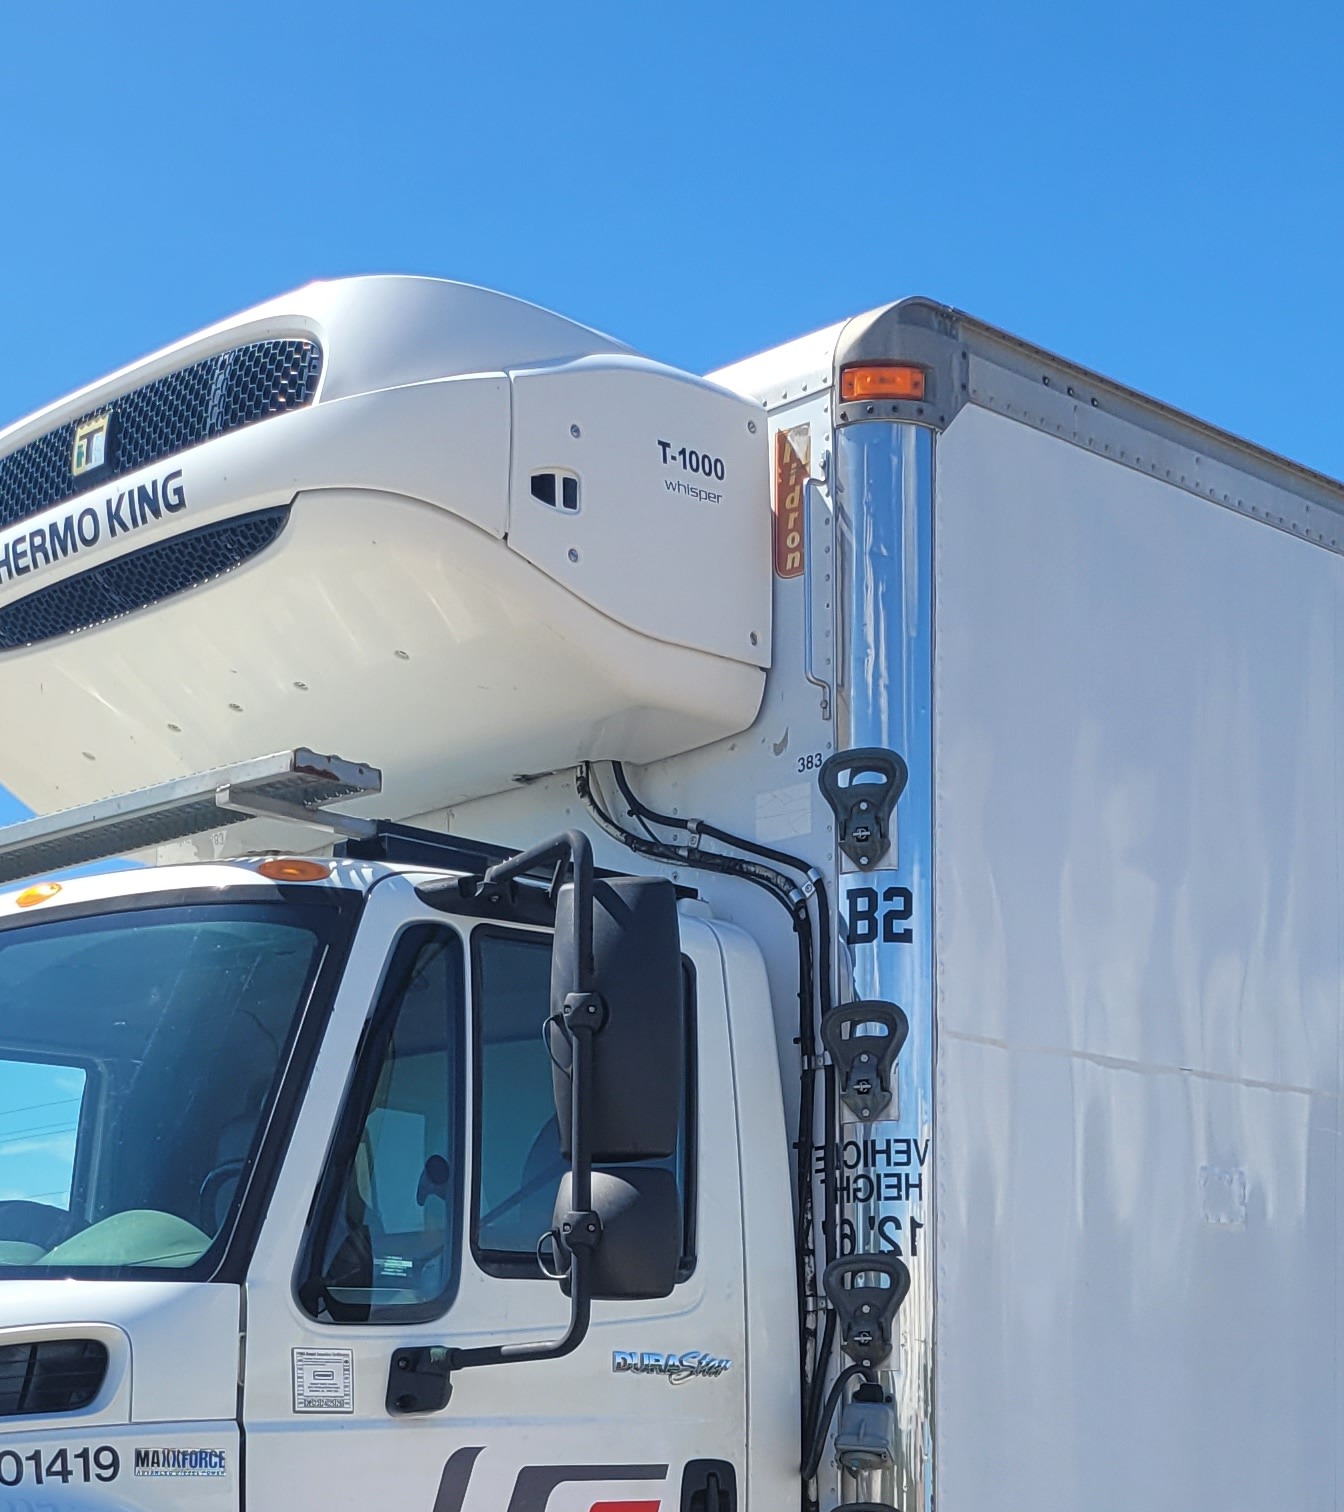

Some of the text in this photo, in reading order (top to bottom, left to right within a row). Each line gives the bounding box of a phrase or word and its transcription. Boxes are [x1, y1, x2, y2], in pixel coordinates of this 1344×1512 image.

[657, 439, 725, 481] T-1000
[105, 469, 188, 539] KING
[664, 479, 723, 505] whisper
[797, 752, 824, 774] 383
[846, 886, 914, 945] B2
